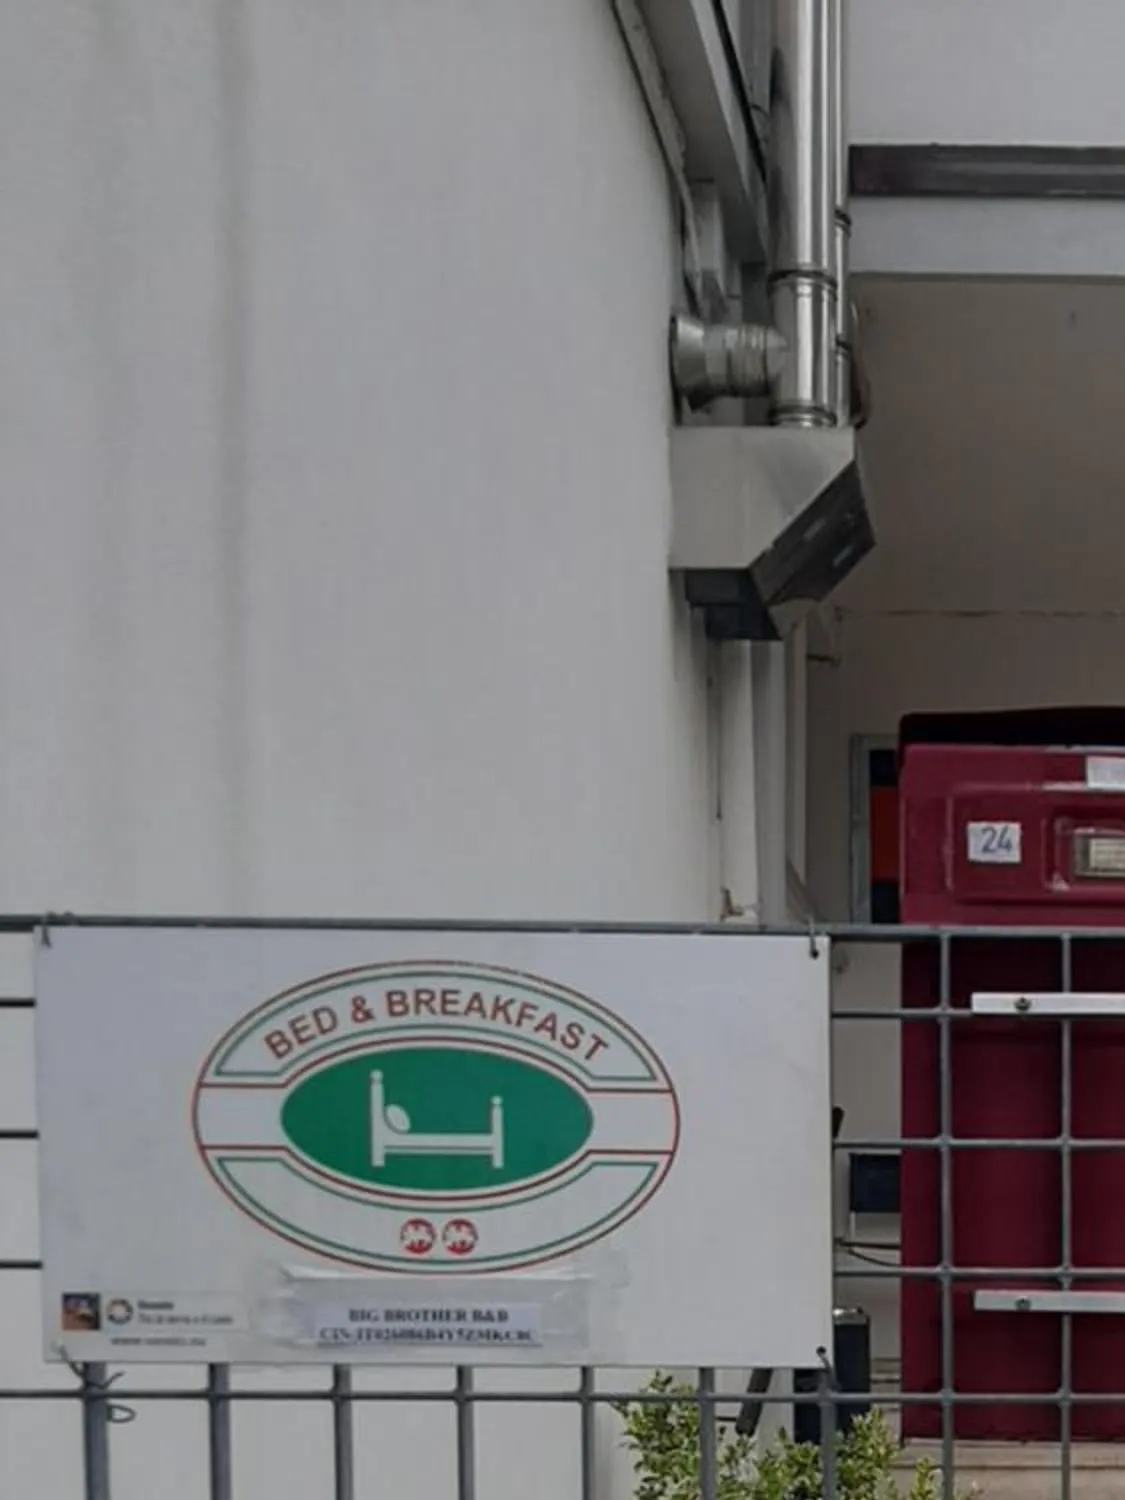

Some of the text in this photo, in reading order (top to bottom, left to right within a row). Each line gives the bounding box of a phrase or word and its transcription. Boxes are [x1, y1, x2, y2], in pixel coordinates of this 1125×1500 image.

[981, 826, 1013, 854] 24
[264, 988, 610, 1063] BED & BREAKFAST
[349, 1308, 379, 1323] BIG
[384, 1308, 467, 1323] BROTHER
